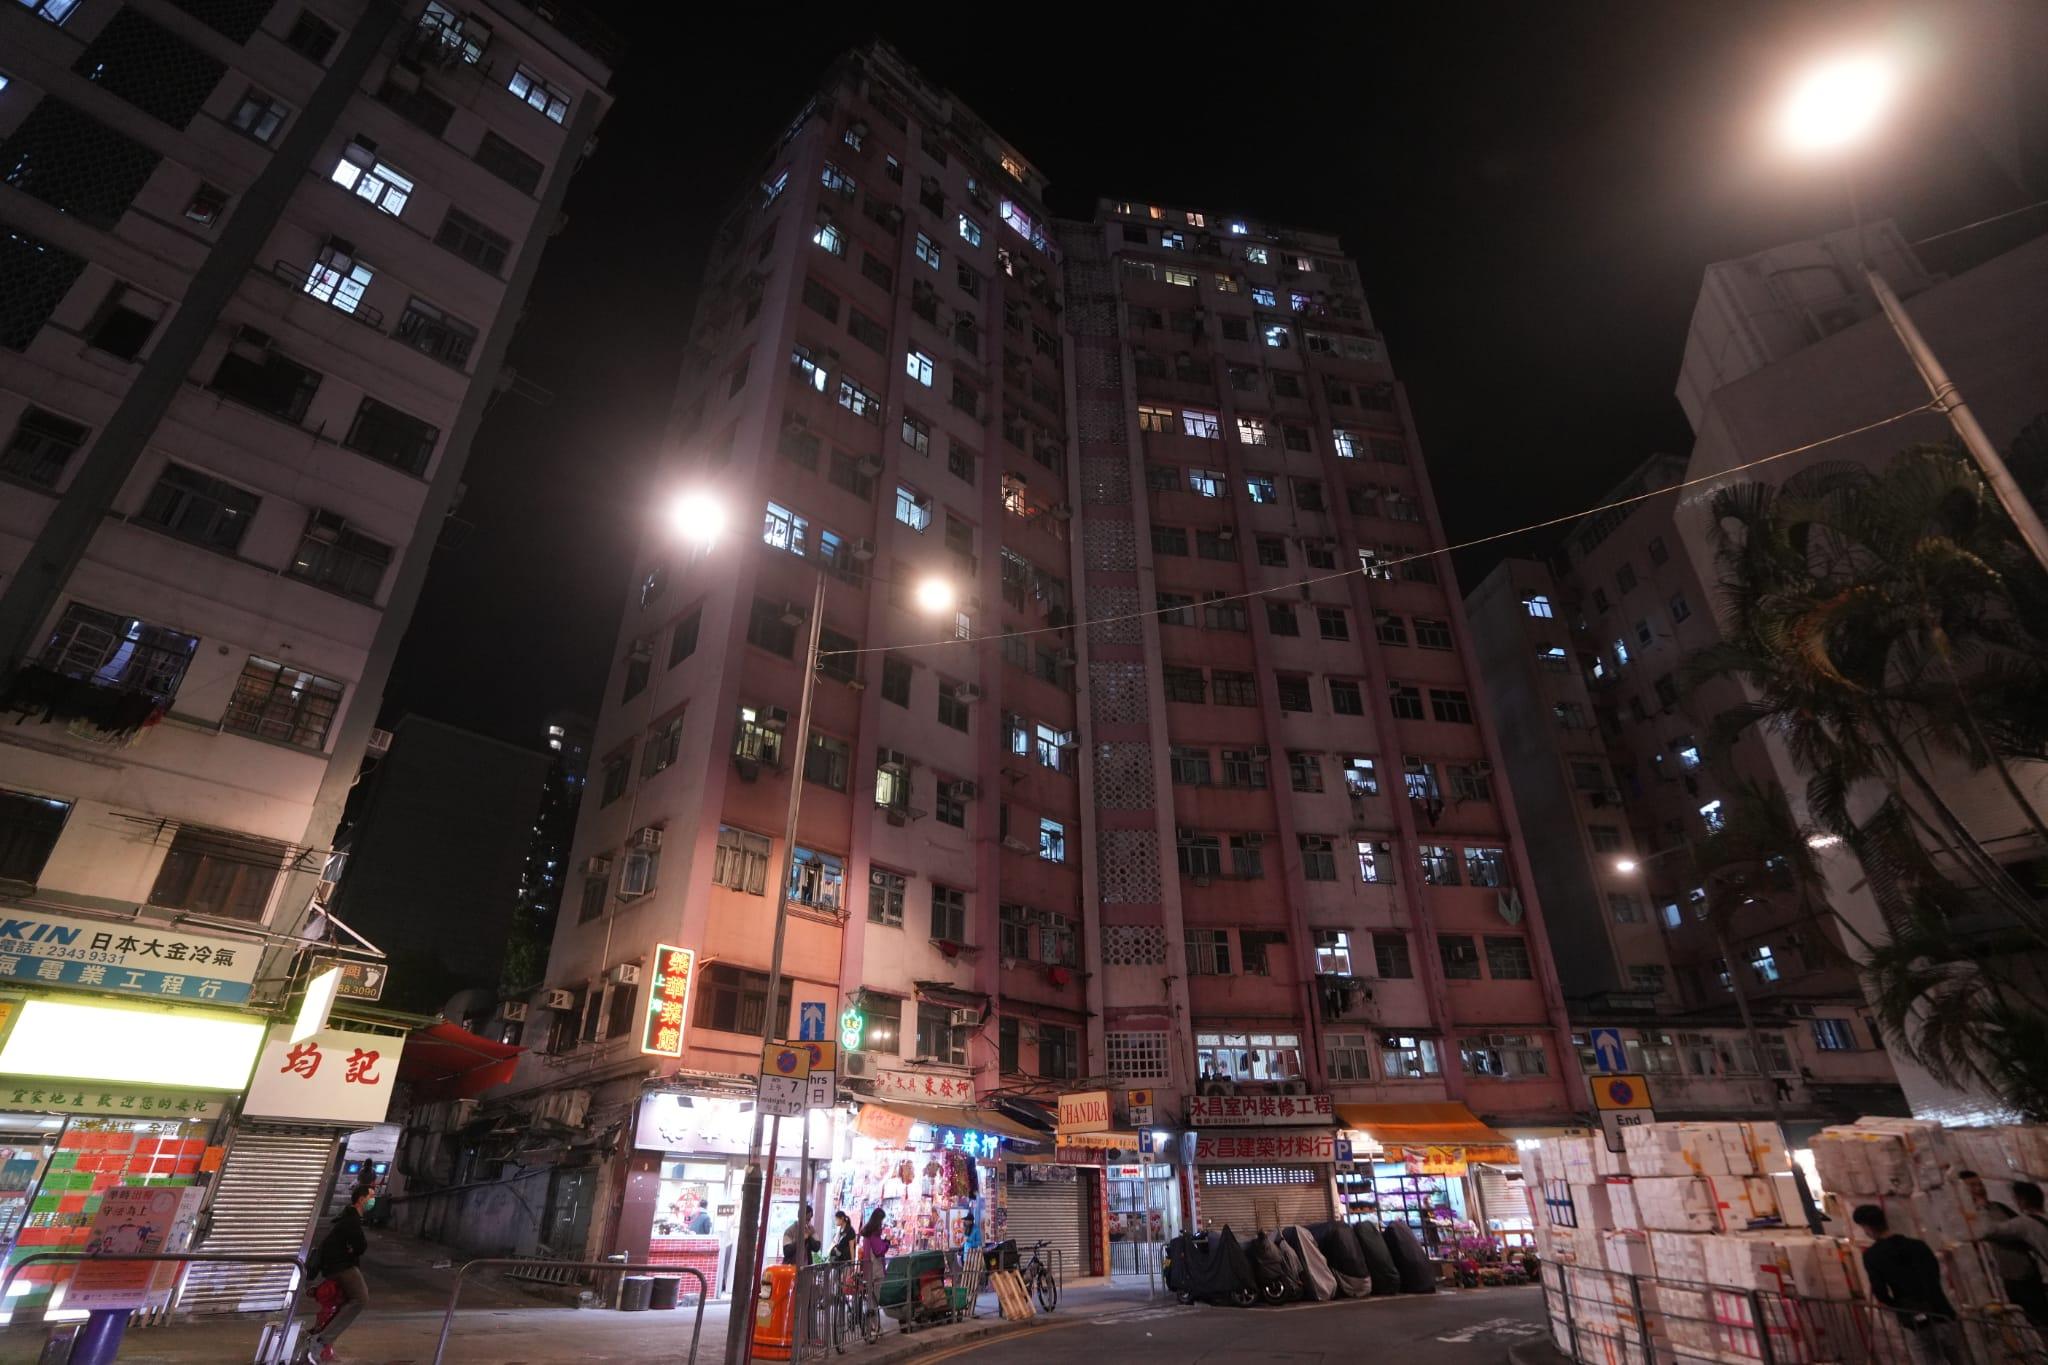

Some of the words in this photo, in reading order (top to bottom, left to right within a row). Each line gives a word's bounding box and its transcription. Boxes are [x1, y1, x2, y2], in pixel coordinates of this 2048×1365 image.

[47, 945, 86, 960] 2343
[88, 951, 126, 965] 9331
[90, 932, 236, 967] 日本大金冷氣
[281, 1042, 381, 1085] 均記
[791, 1081, 799, 1093] 7
[810, 1075, 828, 1085] hrs
[813, 1089, 825, 1104] 日
[1191, 1095, 1333, 1117] 永昌室內裝修工程
[788, 1101, 802, 1114] 12
[1060, 1101, 1107, 1125] CHANDRA
[1616, 1113, 1641, 1126] End
[1142, 1132, 1151, 1151] P
[1196, 1136, 1334, 1159] 永昌建築材料行
[1336, 1141, 1349, 1161] P
